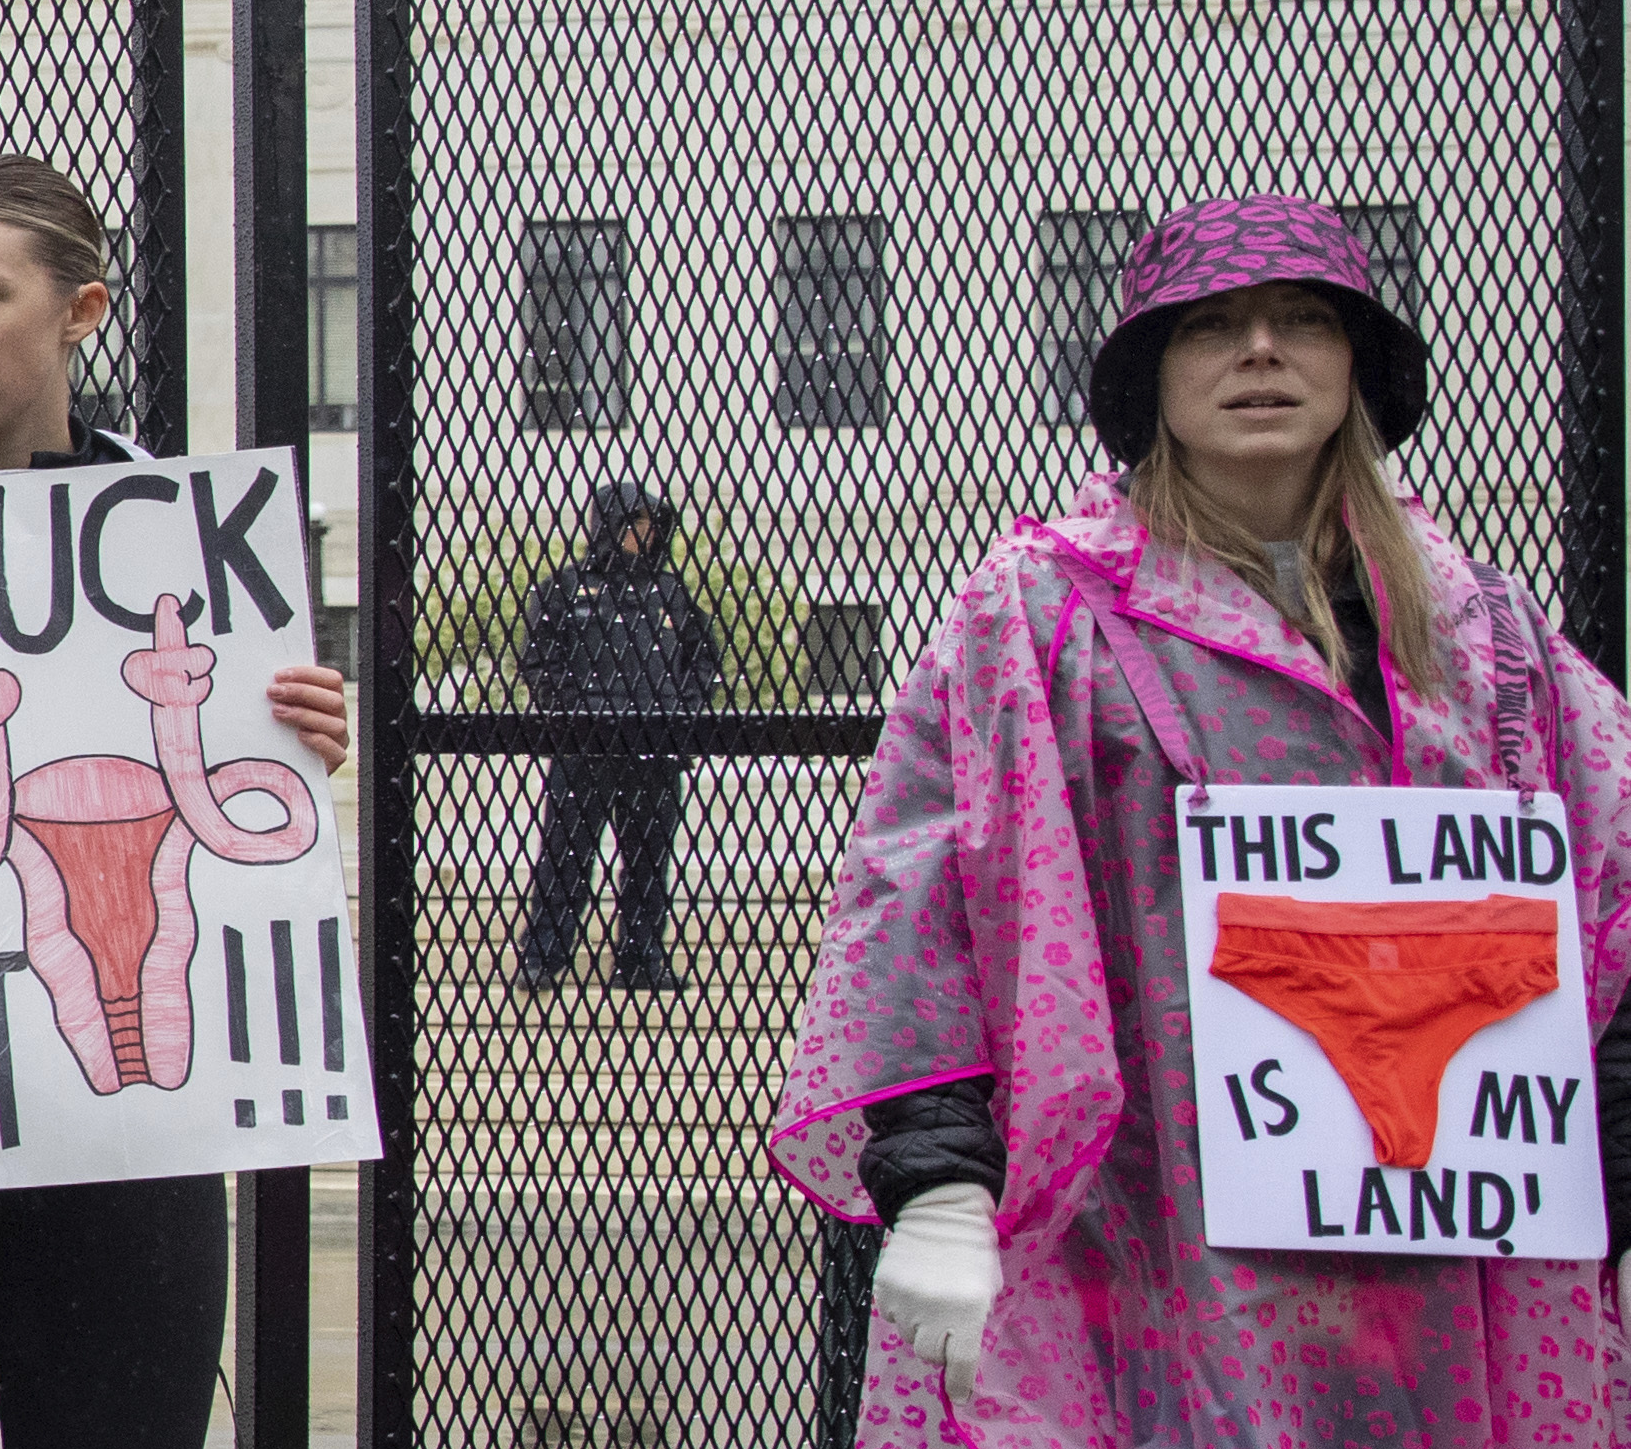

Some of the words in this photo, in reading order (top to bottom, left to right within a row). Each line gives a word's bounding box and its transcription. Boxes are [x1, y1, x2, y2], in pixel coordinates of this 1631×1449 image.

[1186, 812, 1342, 882] THIS
[1380, 813, 1568, 886] LAND
[1223, 1058, 1300, 1142] IS
[1469, 1070, 1582, 1146] MY
[1302, 1166, 1542, 1256] LAND!
